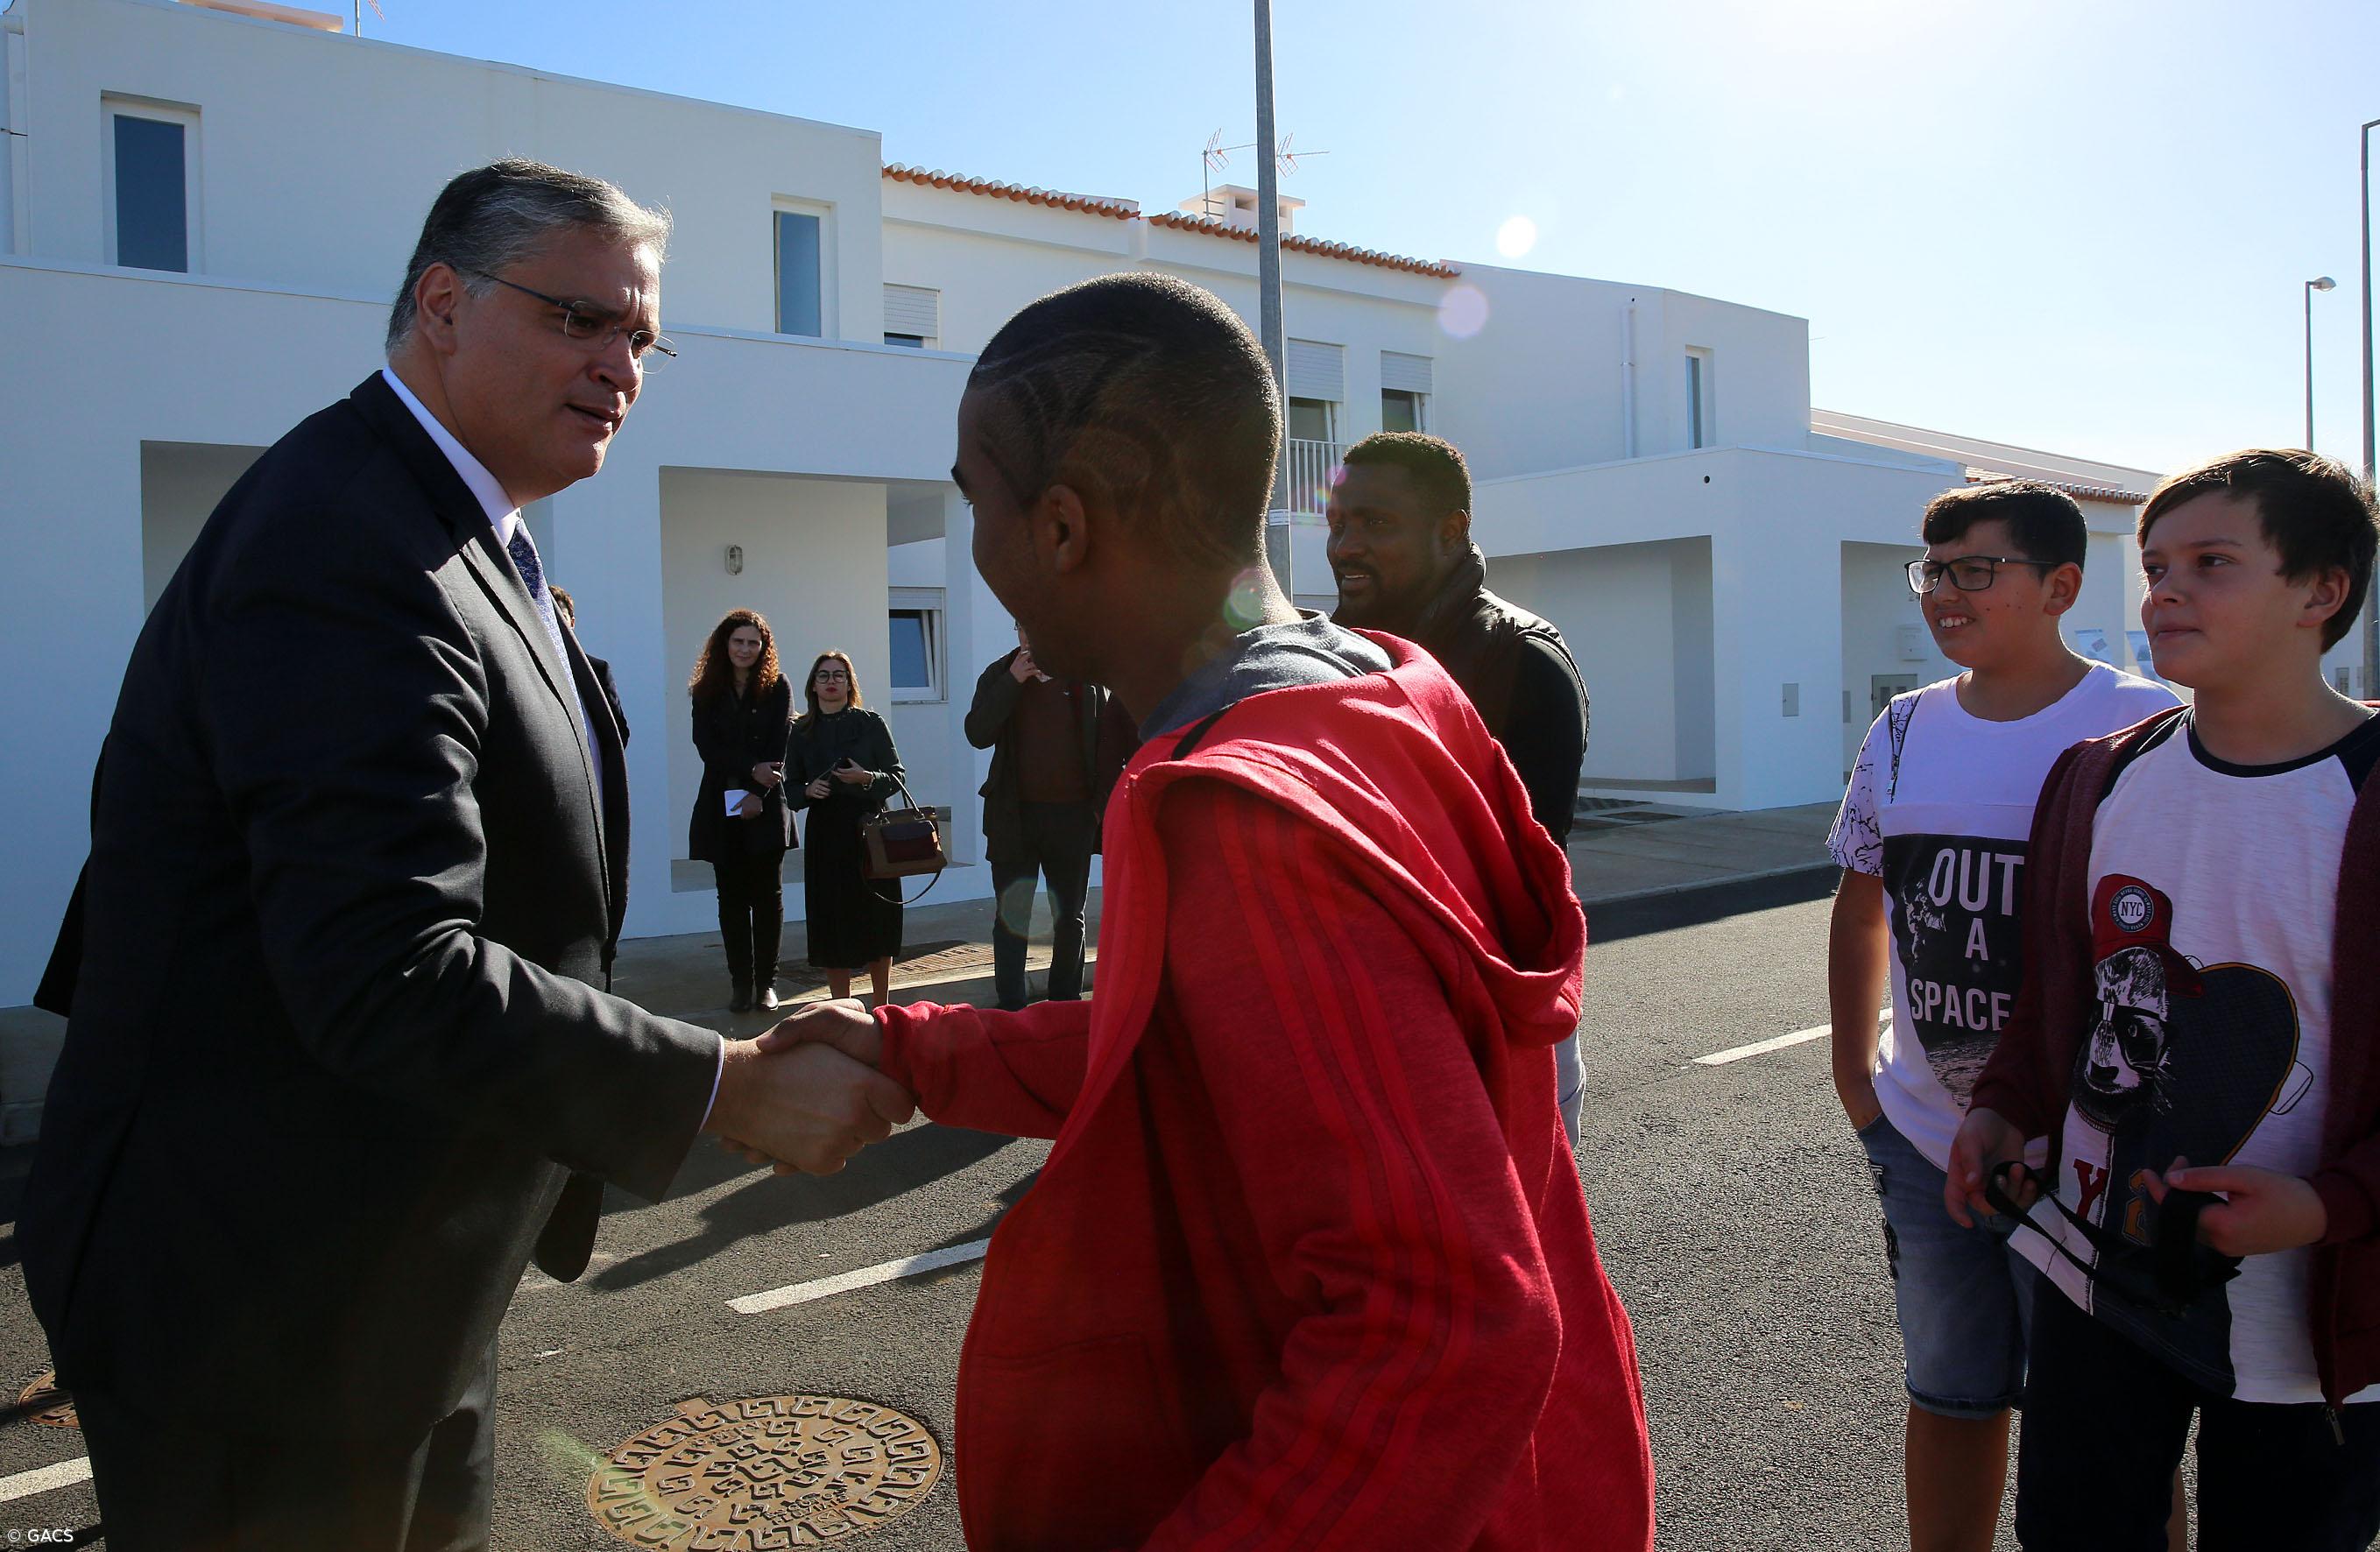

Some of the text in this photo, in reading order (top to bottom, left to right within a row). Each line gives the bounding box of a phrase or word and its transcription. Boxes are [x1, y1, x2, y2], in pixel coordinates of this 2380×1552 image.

[1928, 849, 2025, 916] OUT
[2121, 901, 2143, 916] NYC
[1965, 918, 1988, 961] A
[1911, 978, 2011, 1032] SPACE
